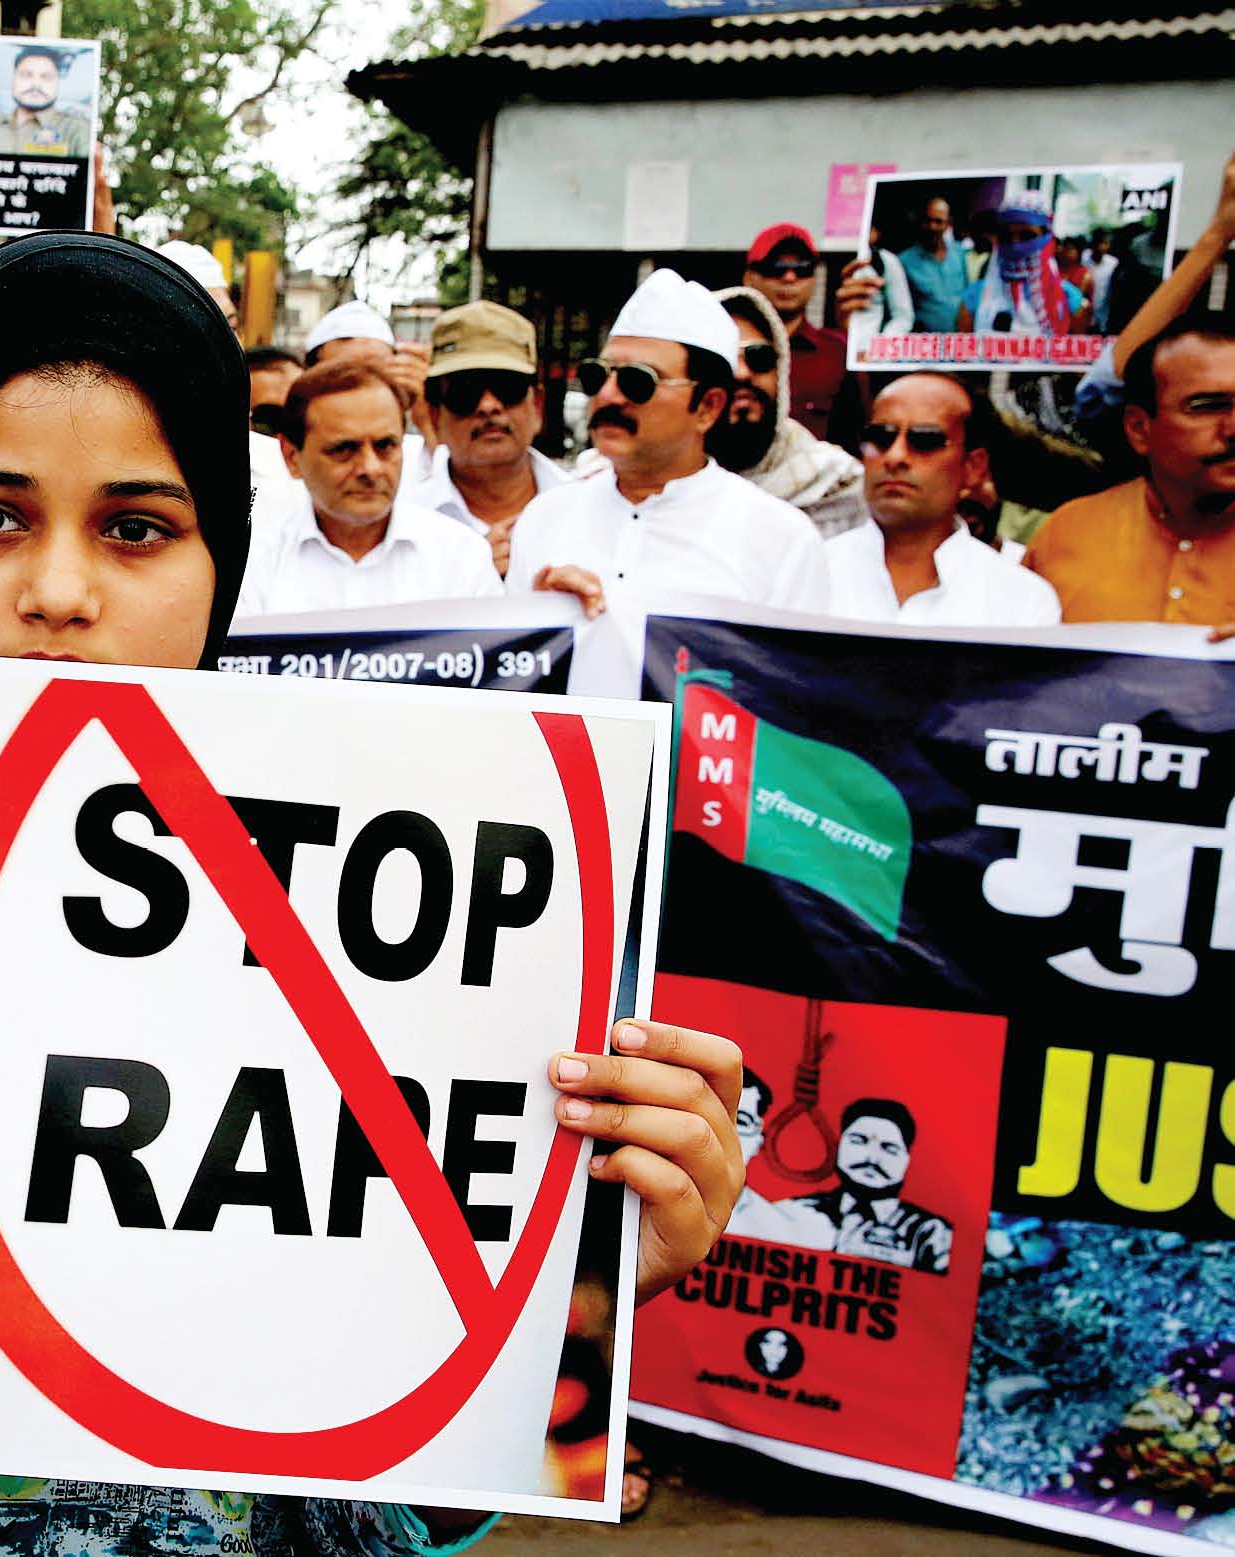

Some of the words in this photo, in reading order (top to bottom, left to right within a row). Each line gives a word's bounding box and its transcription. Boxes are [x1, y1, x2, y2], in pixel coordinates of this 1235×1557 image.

[1122, 190, 1168, 210] ANI
[497, 651, 551, 677] 391
[984, 722, 1210, 790] तालीम
[62, 782, 555, 988] STOP
[24, 1053, 527, 1243] RAPE
[1017, 1047, 1235, 1224] JU
[675, 1267, 899, 1341] CULPRITS
[705, 1240, 819, 1285] UNISH
[829, 1259, 902, 1300] THE
